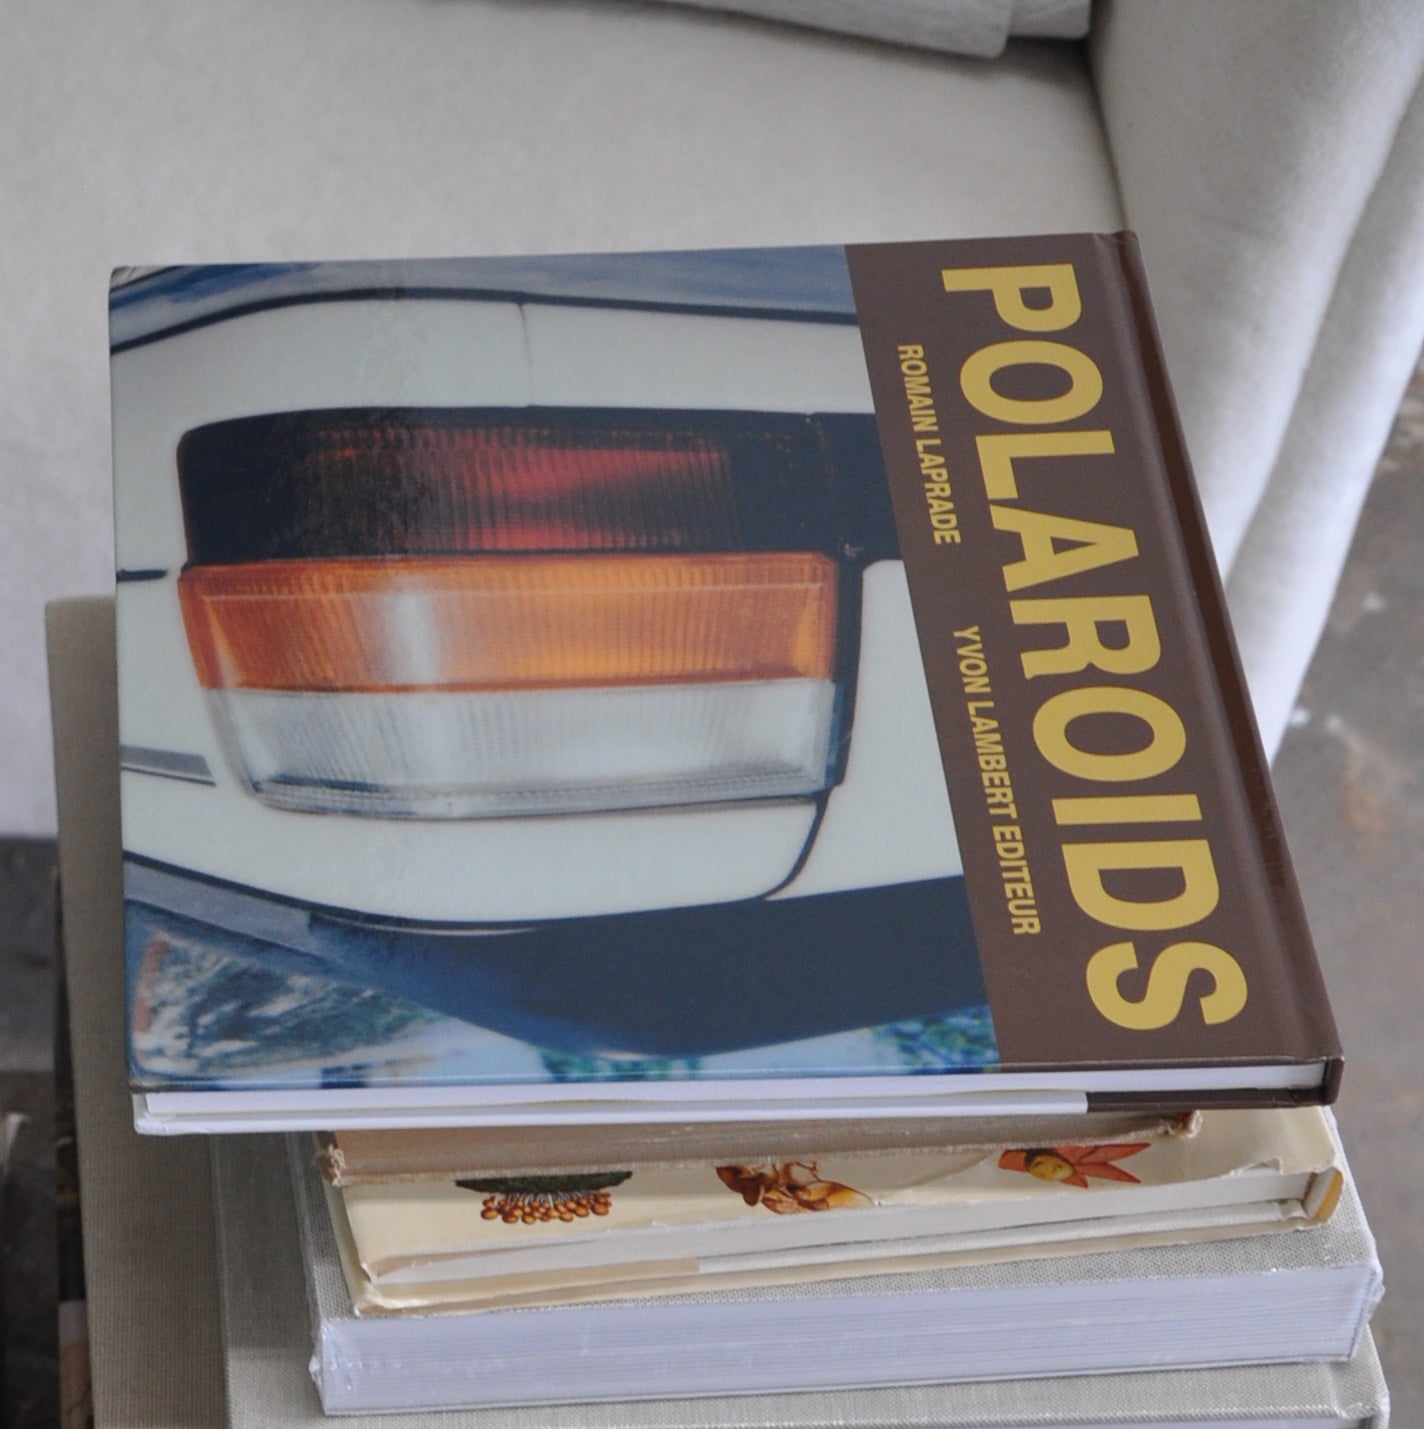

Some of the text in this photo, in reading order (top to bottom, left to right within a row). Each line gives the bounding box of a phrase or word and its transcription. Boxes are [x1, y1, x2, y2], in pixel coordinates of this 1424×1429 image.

[897, 344, 962, 546] ROMAIN LAPRADE
[941, 262, 1249, 1031] POLAROIDS
[952, 626, 1041, 935] YVON LAMBERT EDITEUR
